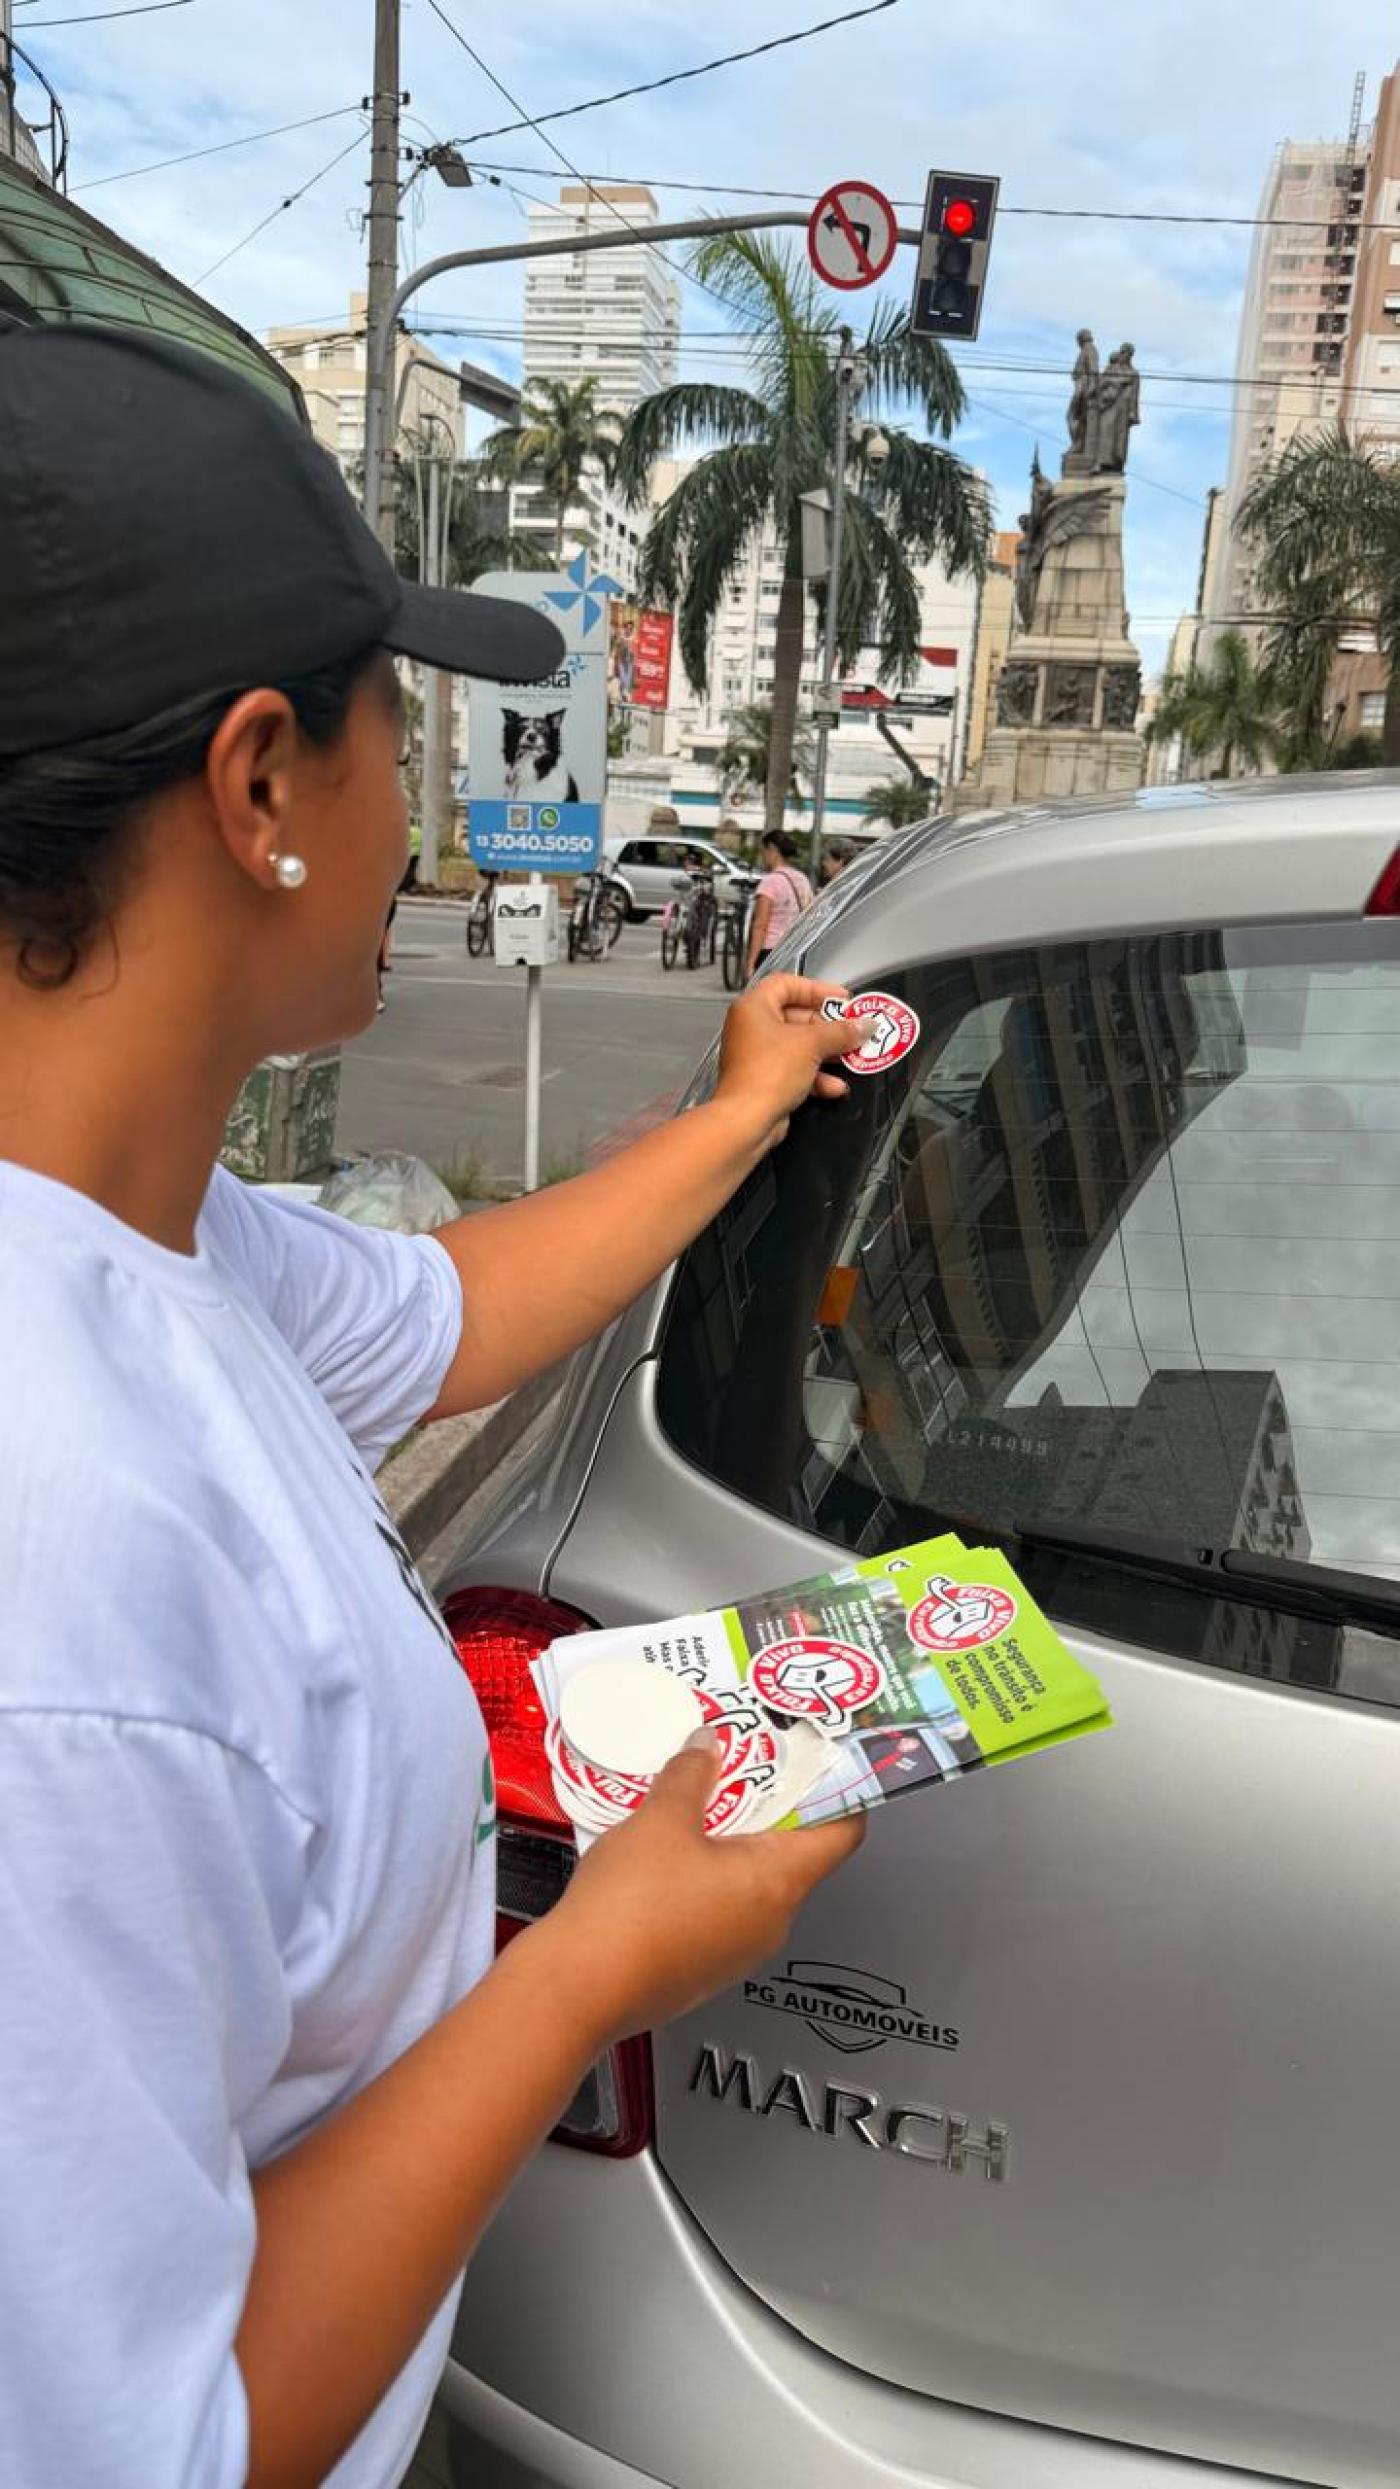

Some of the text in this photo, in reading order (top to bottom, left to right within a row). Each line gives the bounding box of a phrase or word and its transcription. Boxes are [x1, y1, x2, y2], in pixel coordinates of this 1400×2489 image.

[491, 833, 594, 852] 3040.5050
[853, 1000, 913, 1043] Faixa Viva
[756, 1644, 805, 1668] Viva
[946, 1659, 962, 1674] de
[983, 1645, 999, 1661] no
[993, 1660, 1028, 1704] trânsito
[1003, 1638, 1046, 1694] Segurança
[760, 1673, 814, 1711] Faixa
[964, 1652, 1015, 1723] compromisso
[743, 1980, 960, 2047] PG AUTOMOVEIS
[690, 2039, 1012, 2181] MARCH
